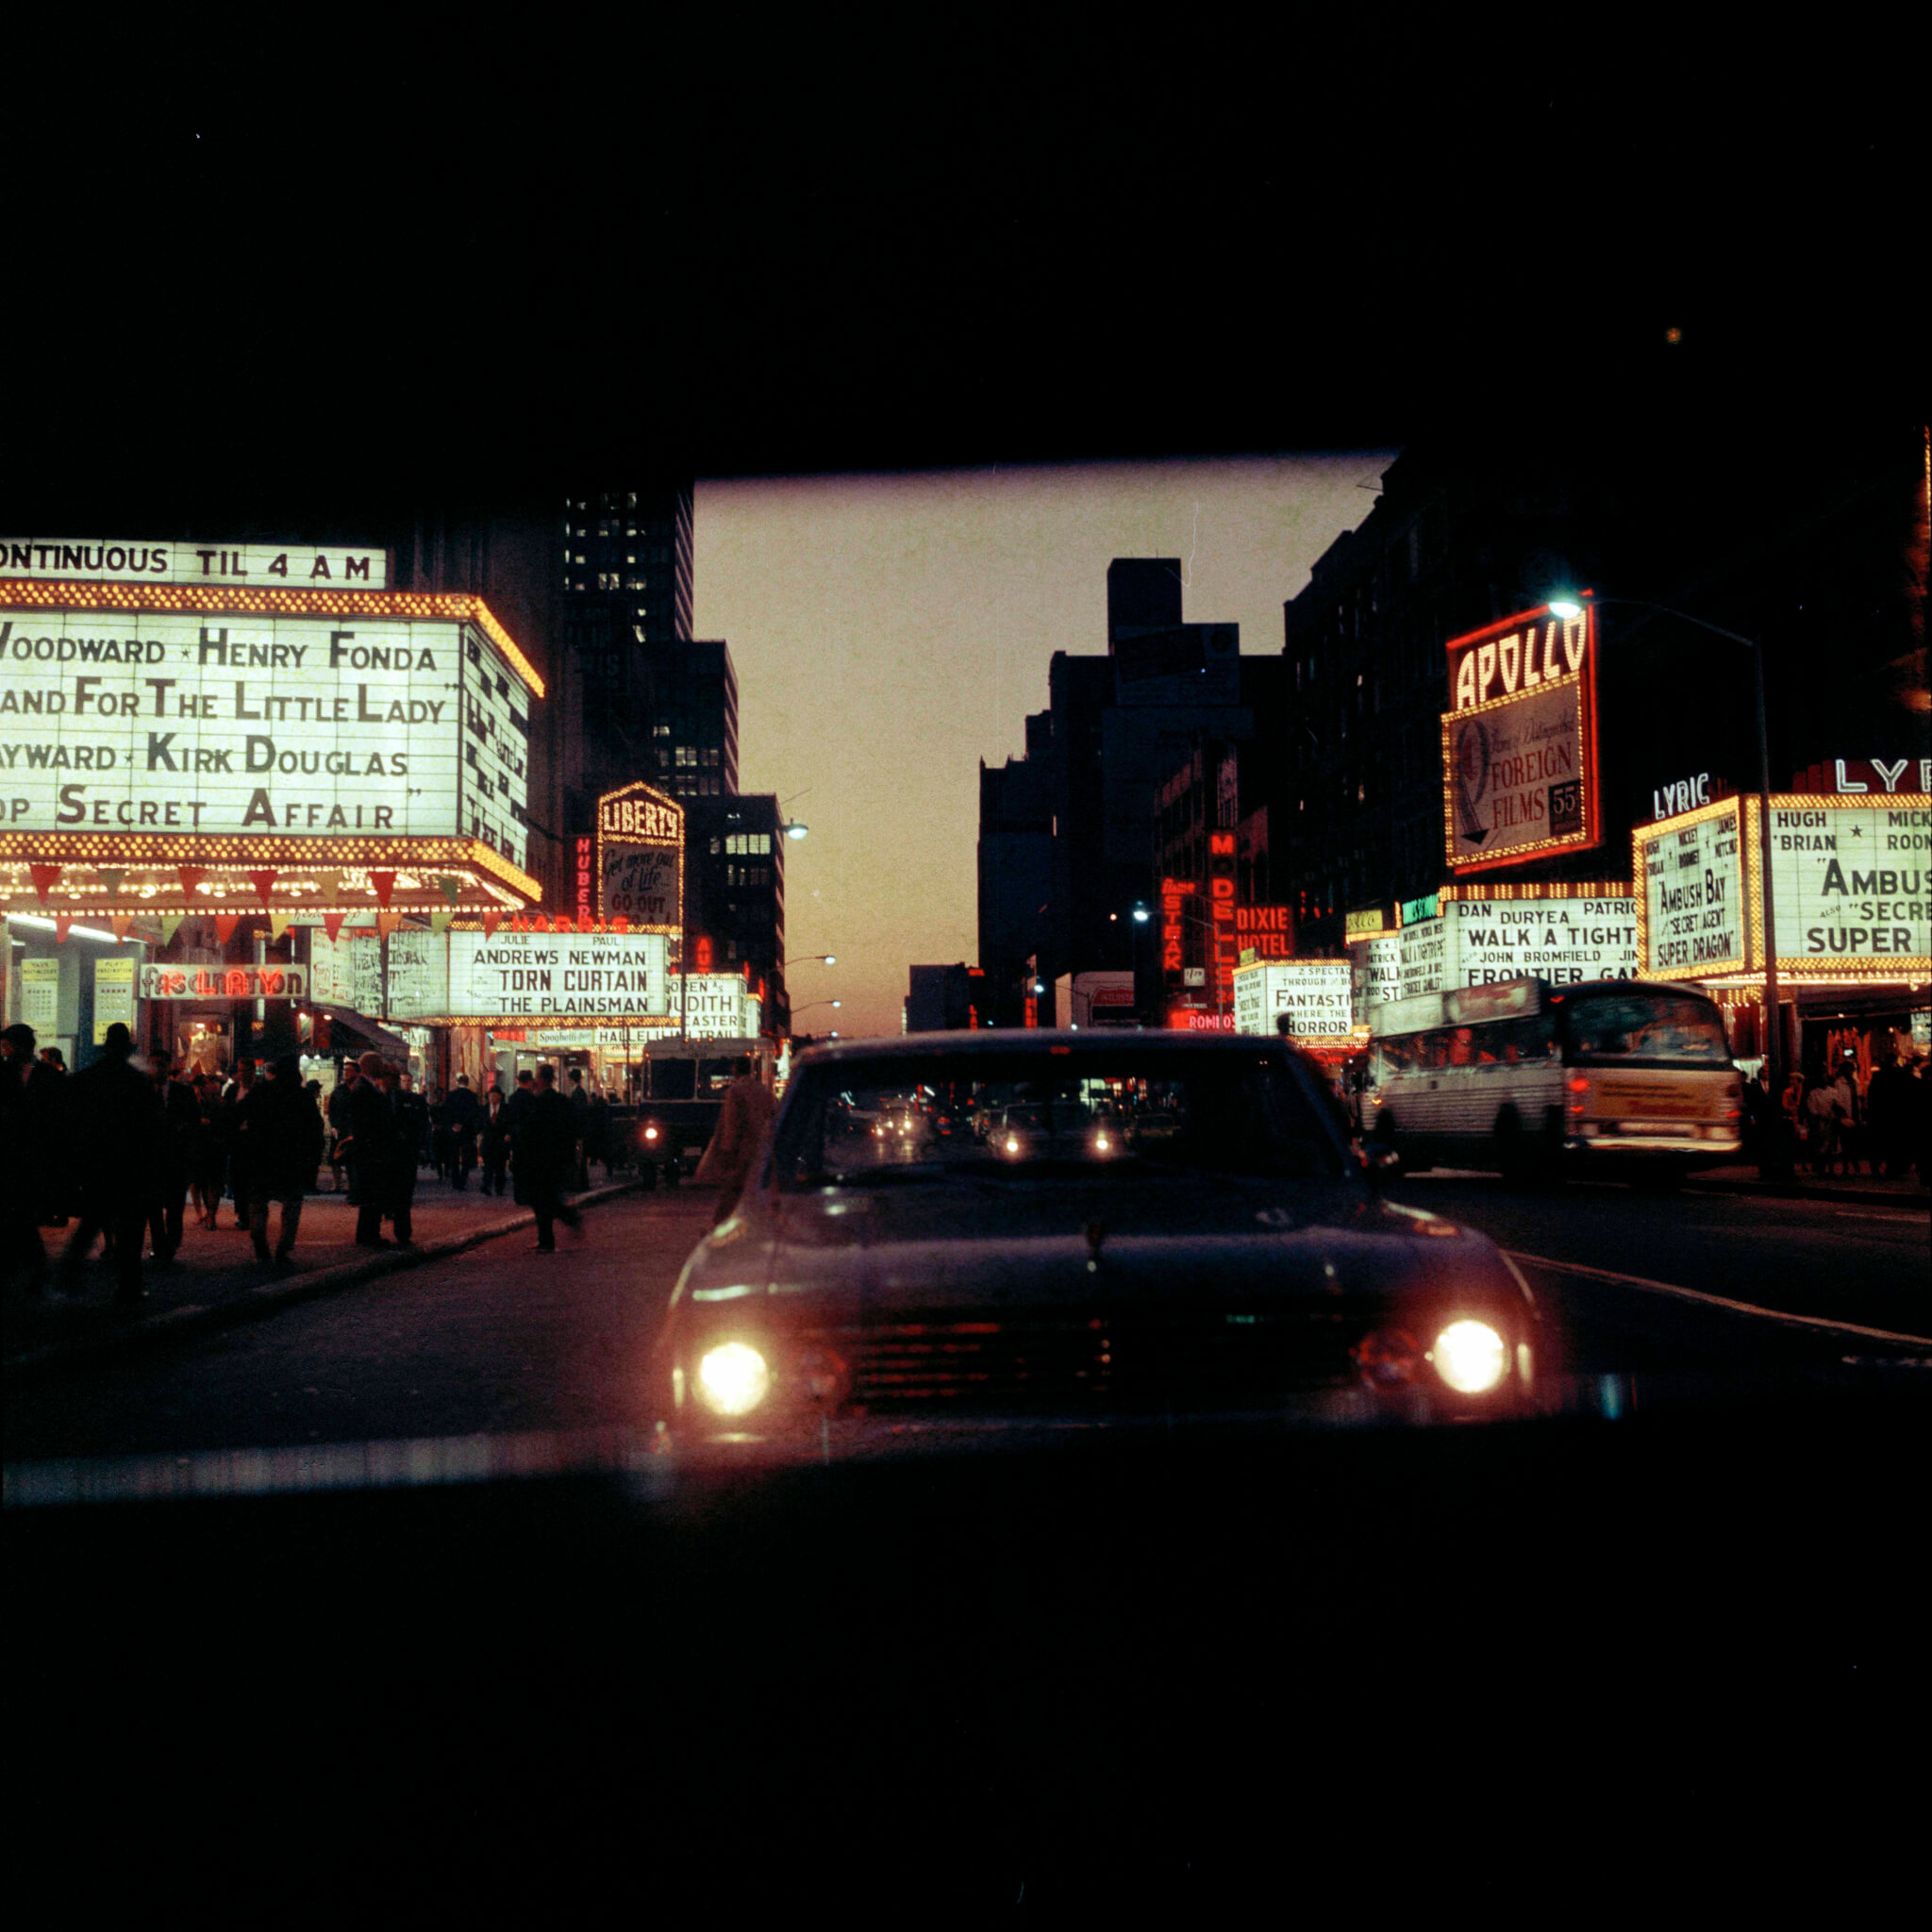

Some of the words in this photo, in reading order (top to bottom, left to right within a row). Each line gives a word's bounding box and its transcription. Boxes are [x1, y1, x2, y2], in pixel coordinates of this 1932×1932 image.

[196, 550, 247, 575] TIL
[268, 554, 288, 577] 4
[198, 627, 308, 668] HENRY
[329, 631, 437, 672] FONDA
[1457, 609, 1586, 709] APOLLO
[75, 676, 140, 717] FOR
[145, 678, 218, 719] THE
[236, 681, 349, 723] LITTLE
[0, 744, 116, 771] YWARD
[147, 732, 233, 774] KIRK
[245, 735, 408, 777] DOUGLAS
[1491, 741, 1573, 791] FOREIGN
[57, 784, 207, 826] SECRET
[1654, 773, 1710, 821] LYRIC
[603, 800, 678, 838] LIBERTY
[1492, 788, 1545, 830] FILMS
[1777, 811, 1826, 827] HUGH
[1889, 811, 1931, 827] MICK
[1773, 835, 1837, 851] 'BRIAN
[611, 893, 631, 911] GO
[638, 895, 666, 913] OUT
[1459, 904, 1491, 917] DAN
[512, 915, 629, 934] HARRIS
[1236, 907, 1289, 931] DIXIE
[1500, 910, 1570, 924] DURYEA
[501, 936, 530, 944] JULIE
[592, 936, 619, 945] PAUL
[1164, 895, 1182, 970] STEAK
[1544, 928, 1557, 945] A
[1567, 927, 1636, 944] TIGHT
[1807, 927, 1912, 953] SUPER
[1237, 934, 1290, 956] HOTEL
[1479, 951, 1513, 963] JOHN
[1524, 950, 1601, 963] BROMFIELD
[1658, 940, 1689, 967] SUPER
[474, 950, 558, 964] ANDREWS
[569, 951, 646, 965] NEWMAN
[161, 967, 282, 996] PLAY
[671, 982, 708, 992] OEN
[1282, 977, 1326, 986] THROUGH
[669, 996, 731, 1012] UDITH
[1276, 990, 1349, 1007] FANTASTI
